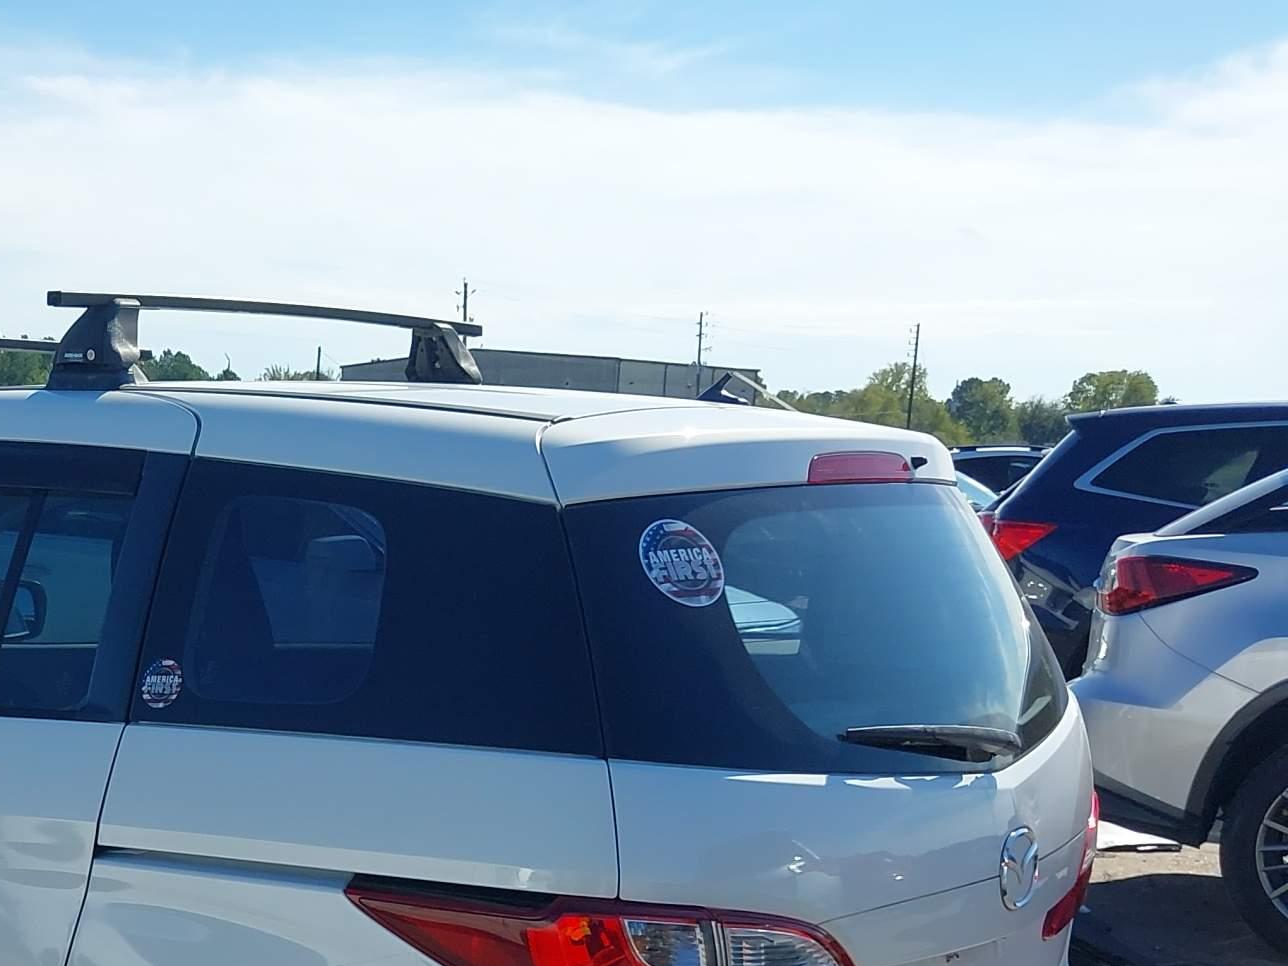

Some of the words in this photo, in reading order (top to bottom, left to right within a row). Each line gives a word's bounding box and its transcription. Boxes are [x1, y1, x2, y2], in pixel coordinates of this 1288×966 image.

[648, 547, 712, 564] AMERICA
[651, 560, 718, 583] FIRST
[145, 674, 180, 683] AMERICA
